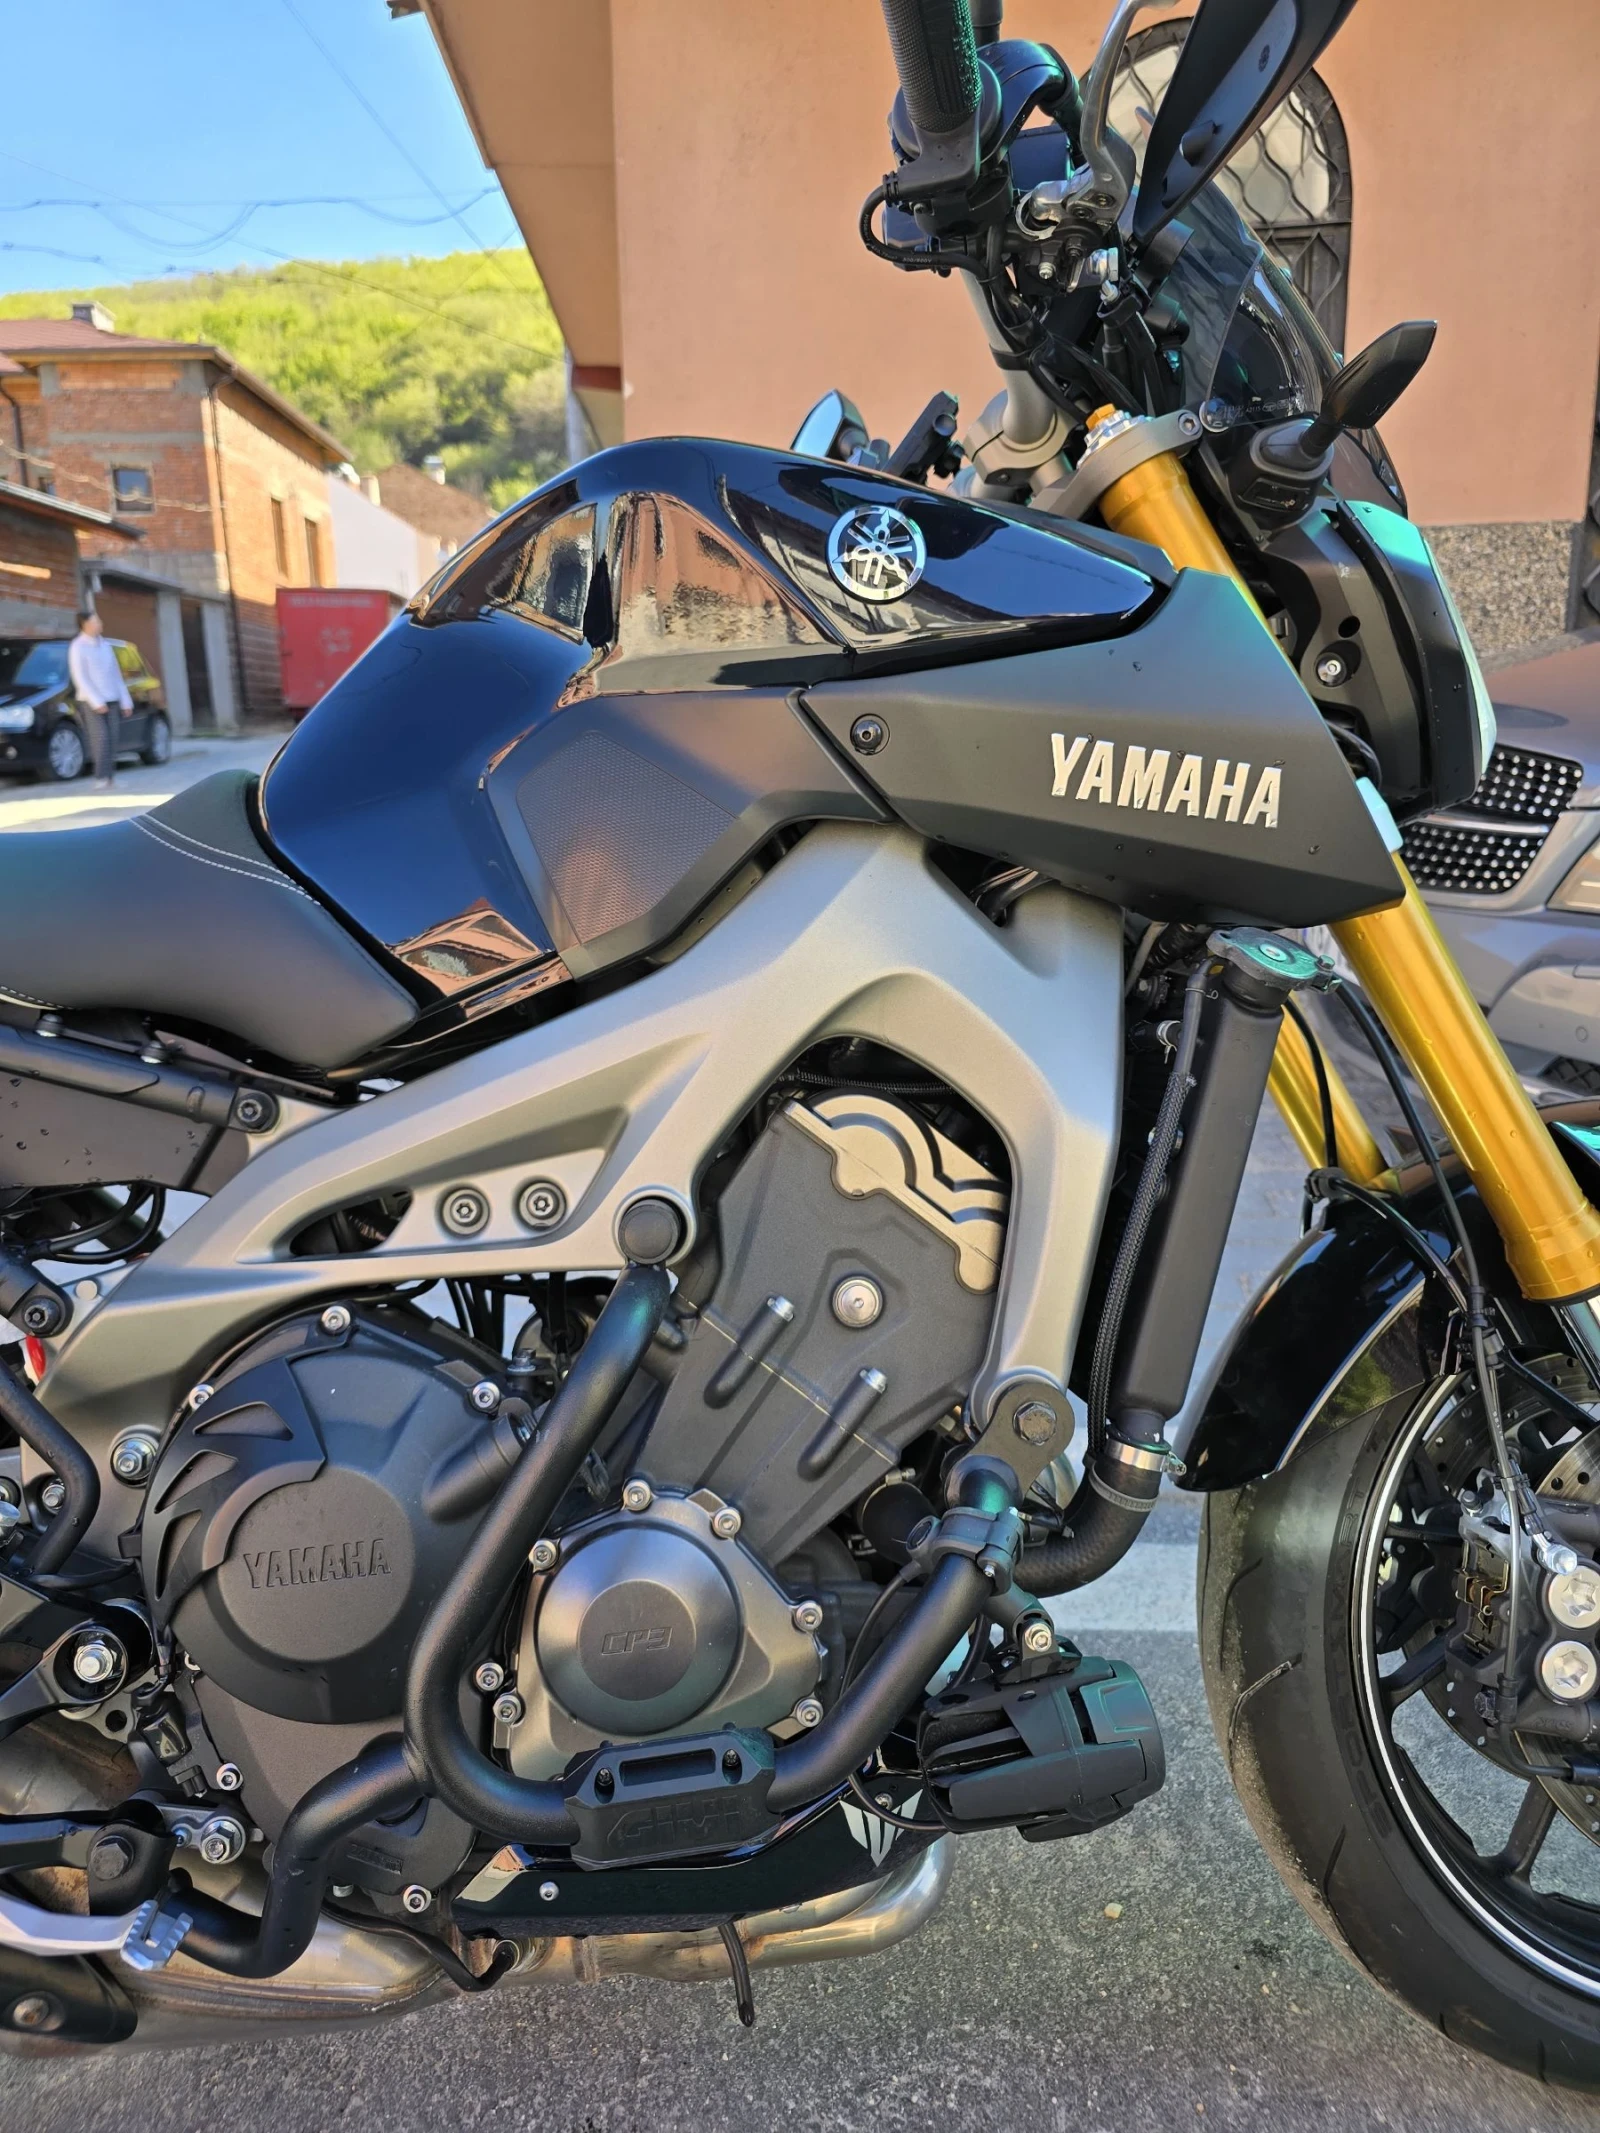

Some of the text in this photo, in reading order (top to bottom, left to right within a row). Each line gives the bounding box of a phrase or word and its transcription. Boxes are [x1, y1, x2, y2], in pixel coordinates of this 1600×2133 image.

[1051, 732, 1282, 828] YAMAHA
[243, 1538, 392, 1589] YAMAHA
[601, 1626, 673, 1656] CP3
